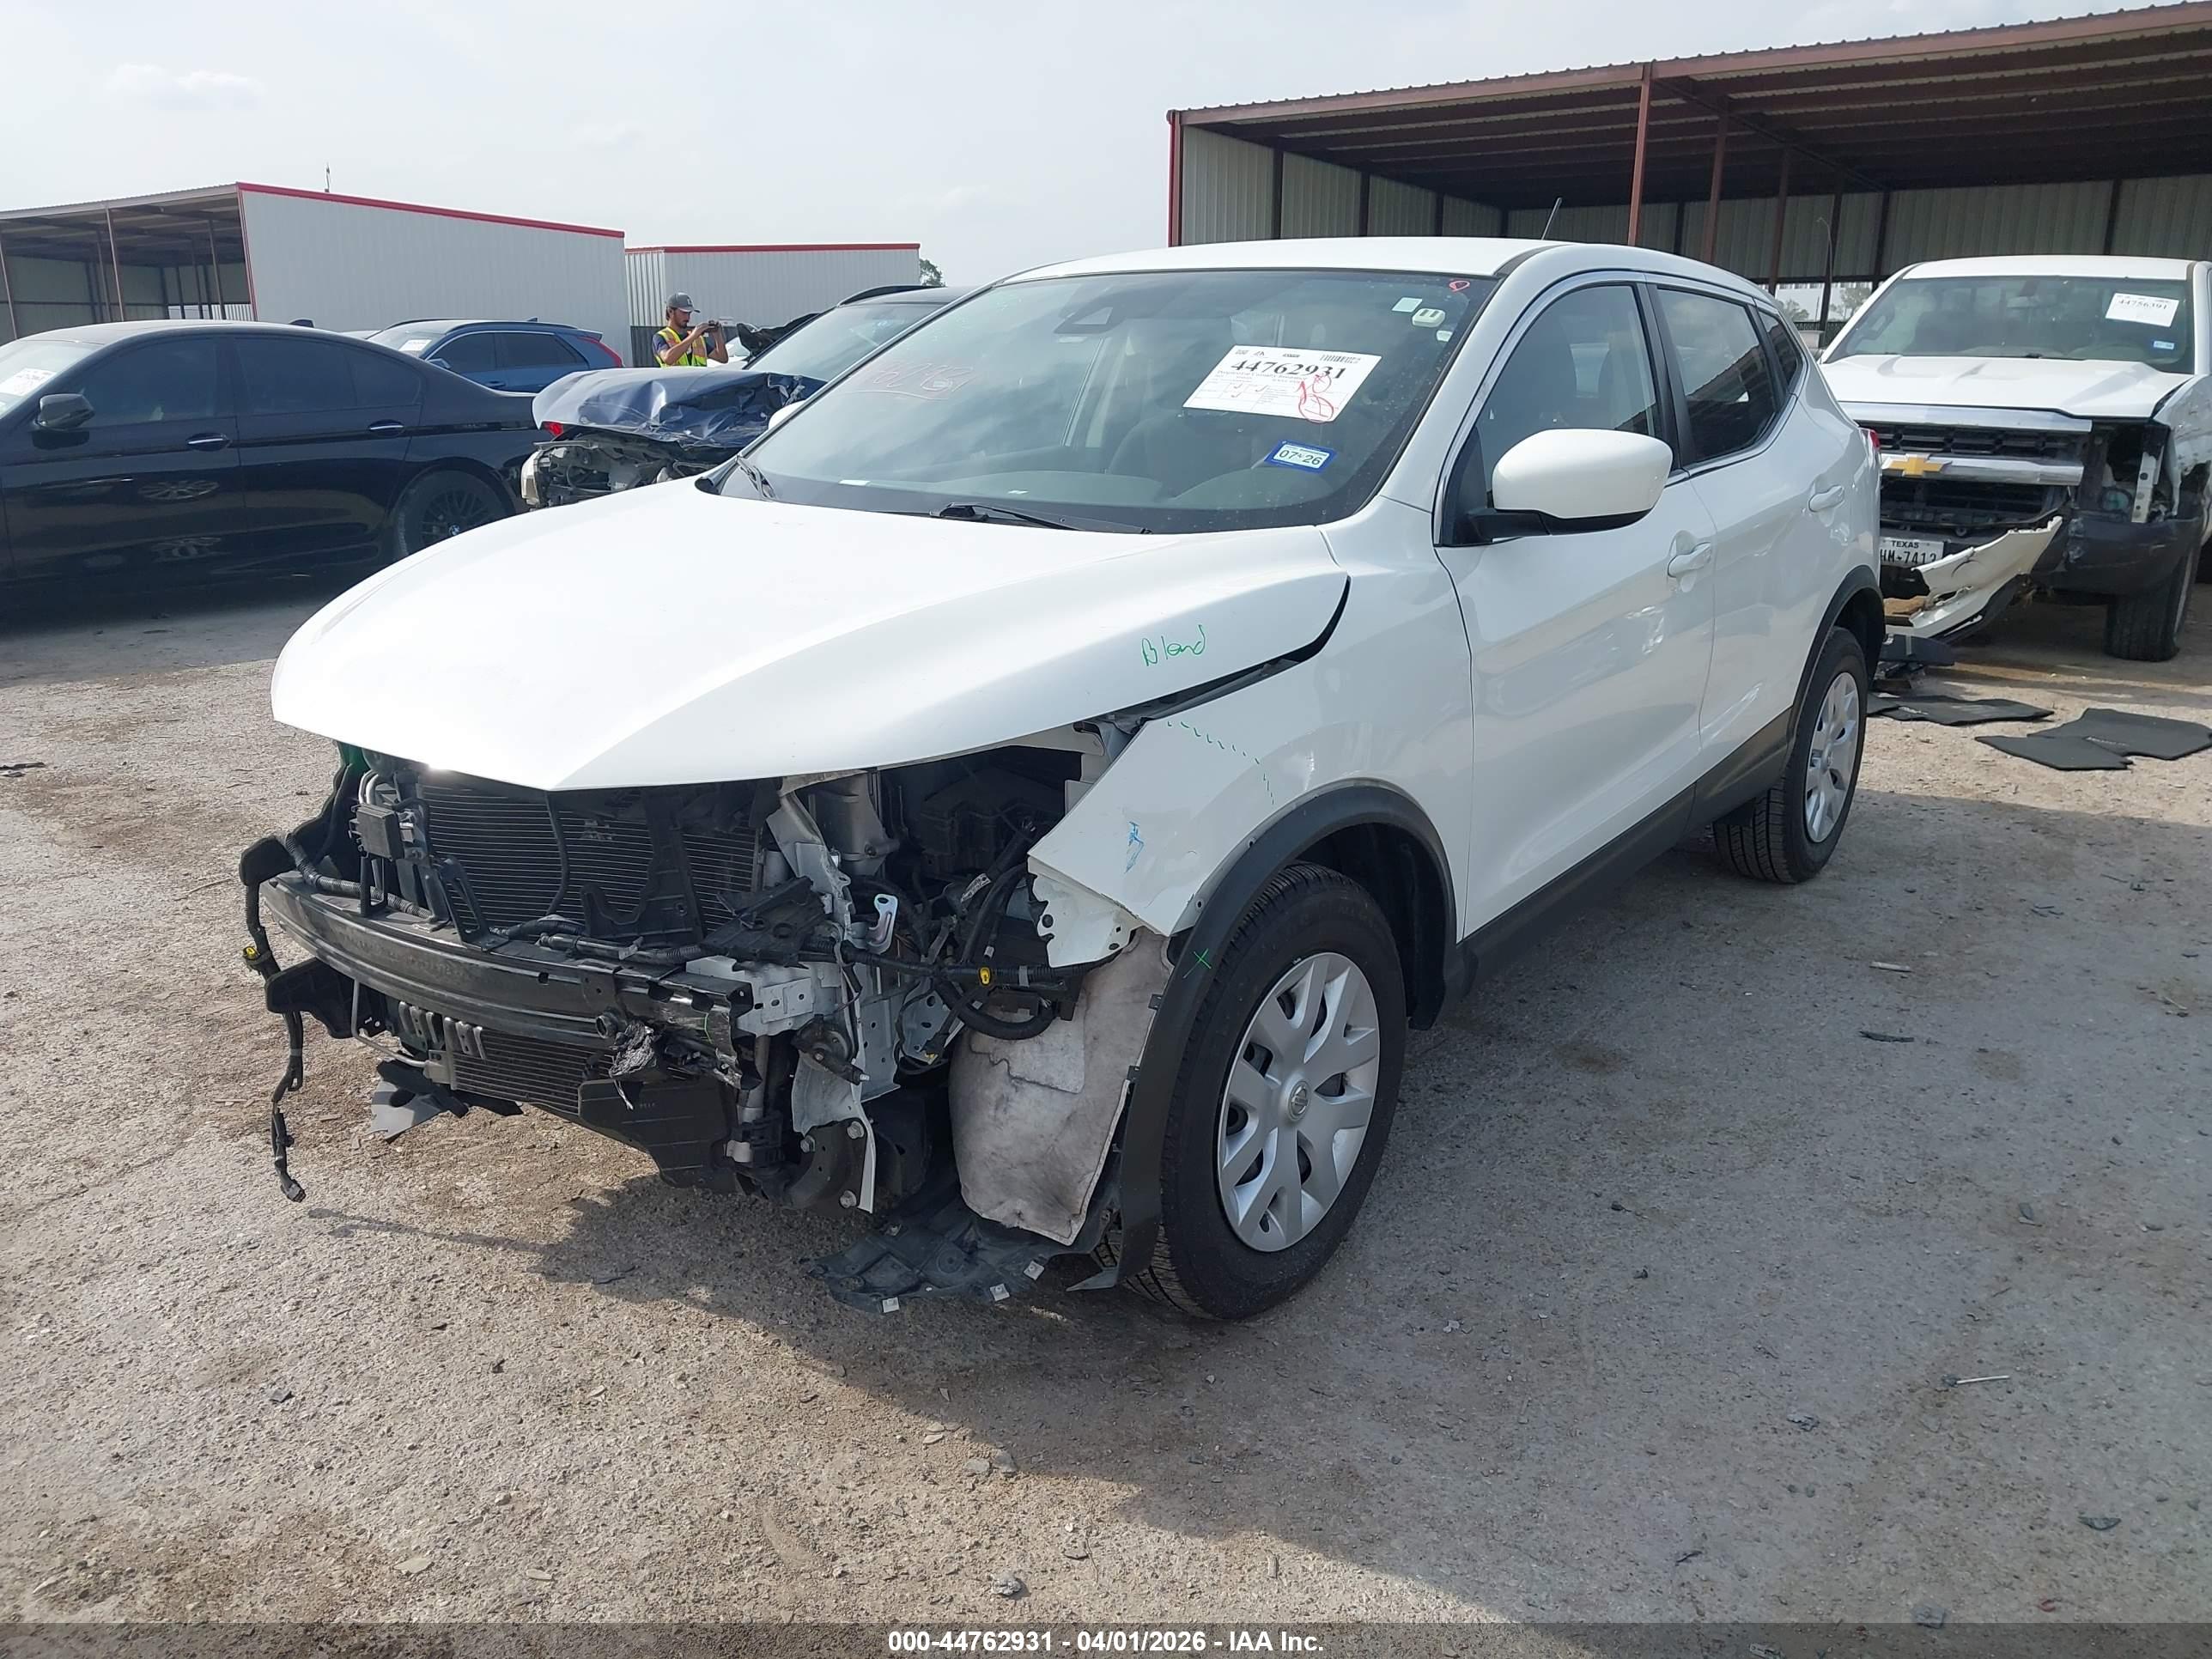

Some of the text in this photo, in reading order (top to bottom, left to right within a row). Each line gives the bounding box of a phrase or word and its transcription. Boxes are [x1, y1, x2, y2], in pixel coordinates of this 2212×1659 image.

[1231, 359, 1346, 379] 44762931
[1279, 449, 1298, 459] 07
[1302, 454, 1323, 465] 26
[1892, 540, 1919, 549] TEXAS
